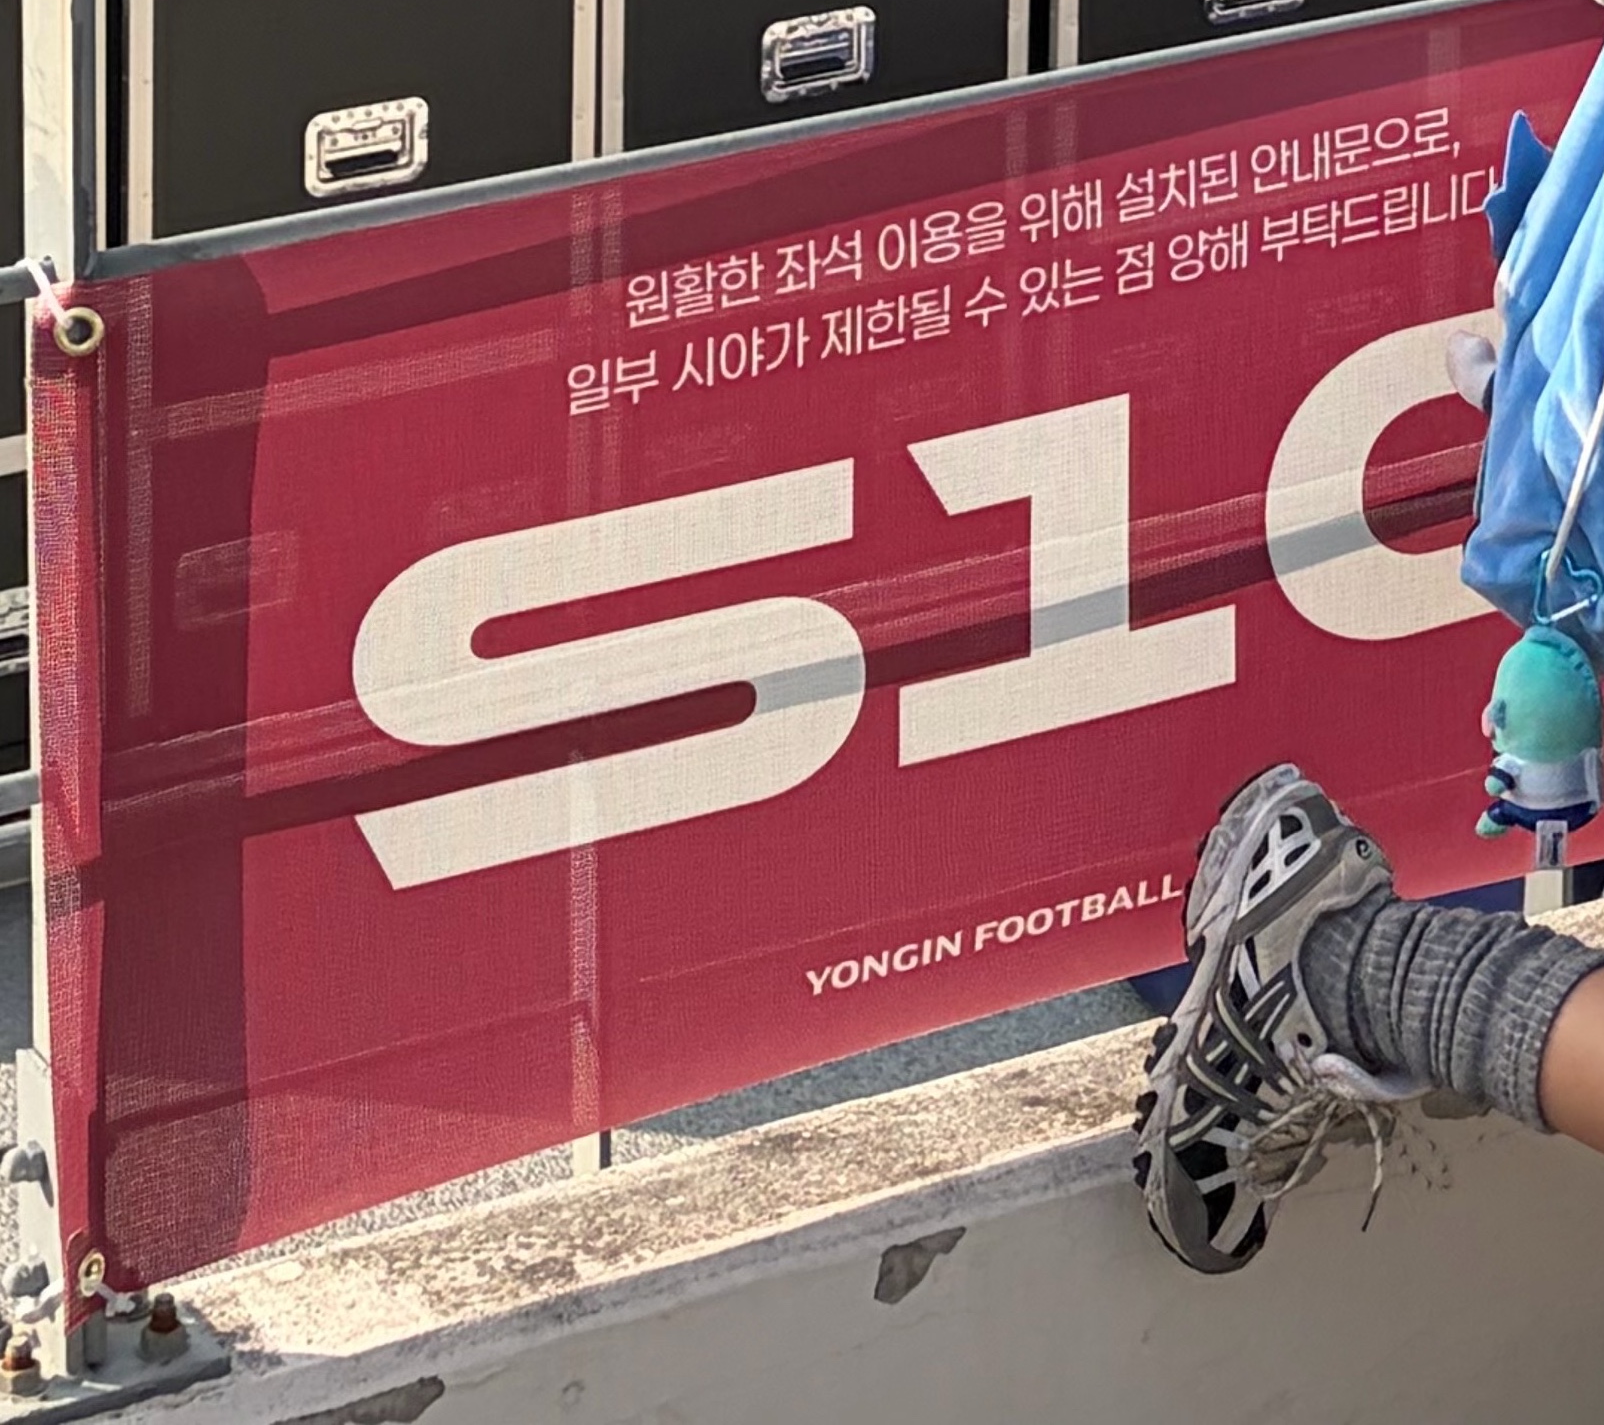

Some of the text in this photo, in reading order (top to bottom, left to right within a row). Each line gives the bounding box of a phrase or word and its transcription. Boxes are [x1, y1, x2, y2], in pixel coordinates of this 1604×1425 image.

[626, 108, 1460, 328] 원활한 좌석 이용을 위해 설치된 안내문으로,
[568, 350, 659, 415] 일부
[673, 318, 809, 390] 시야가
[821, 285, 950, 358] 제한될
[965, 277, 1007, 327] 수
[1020, 259, 1103, 316] 있는
[1117, 242, 1154, 294] 점
[1169, 220, 1248, 281] 양해
[807, 875, 1182, 995] YONGIN FOOTBALL
